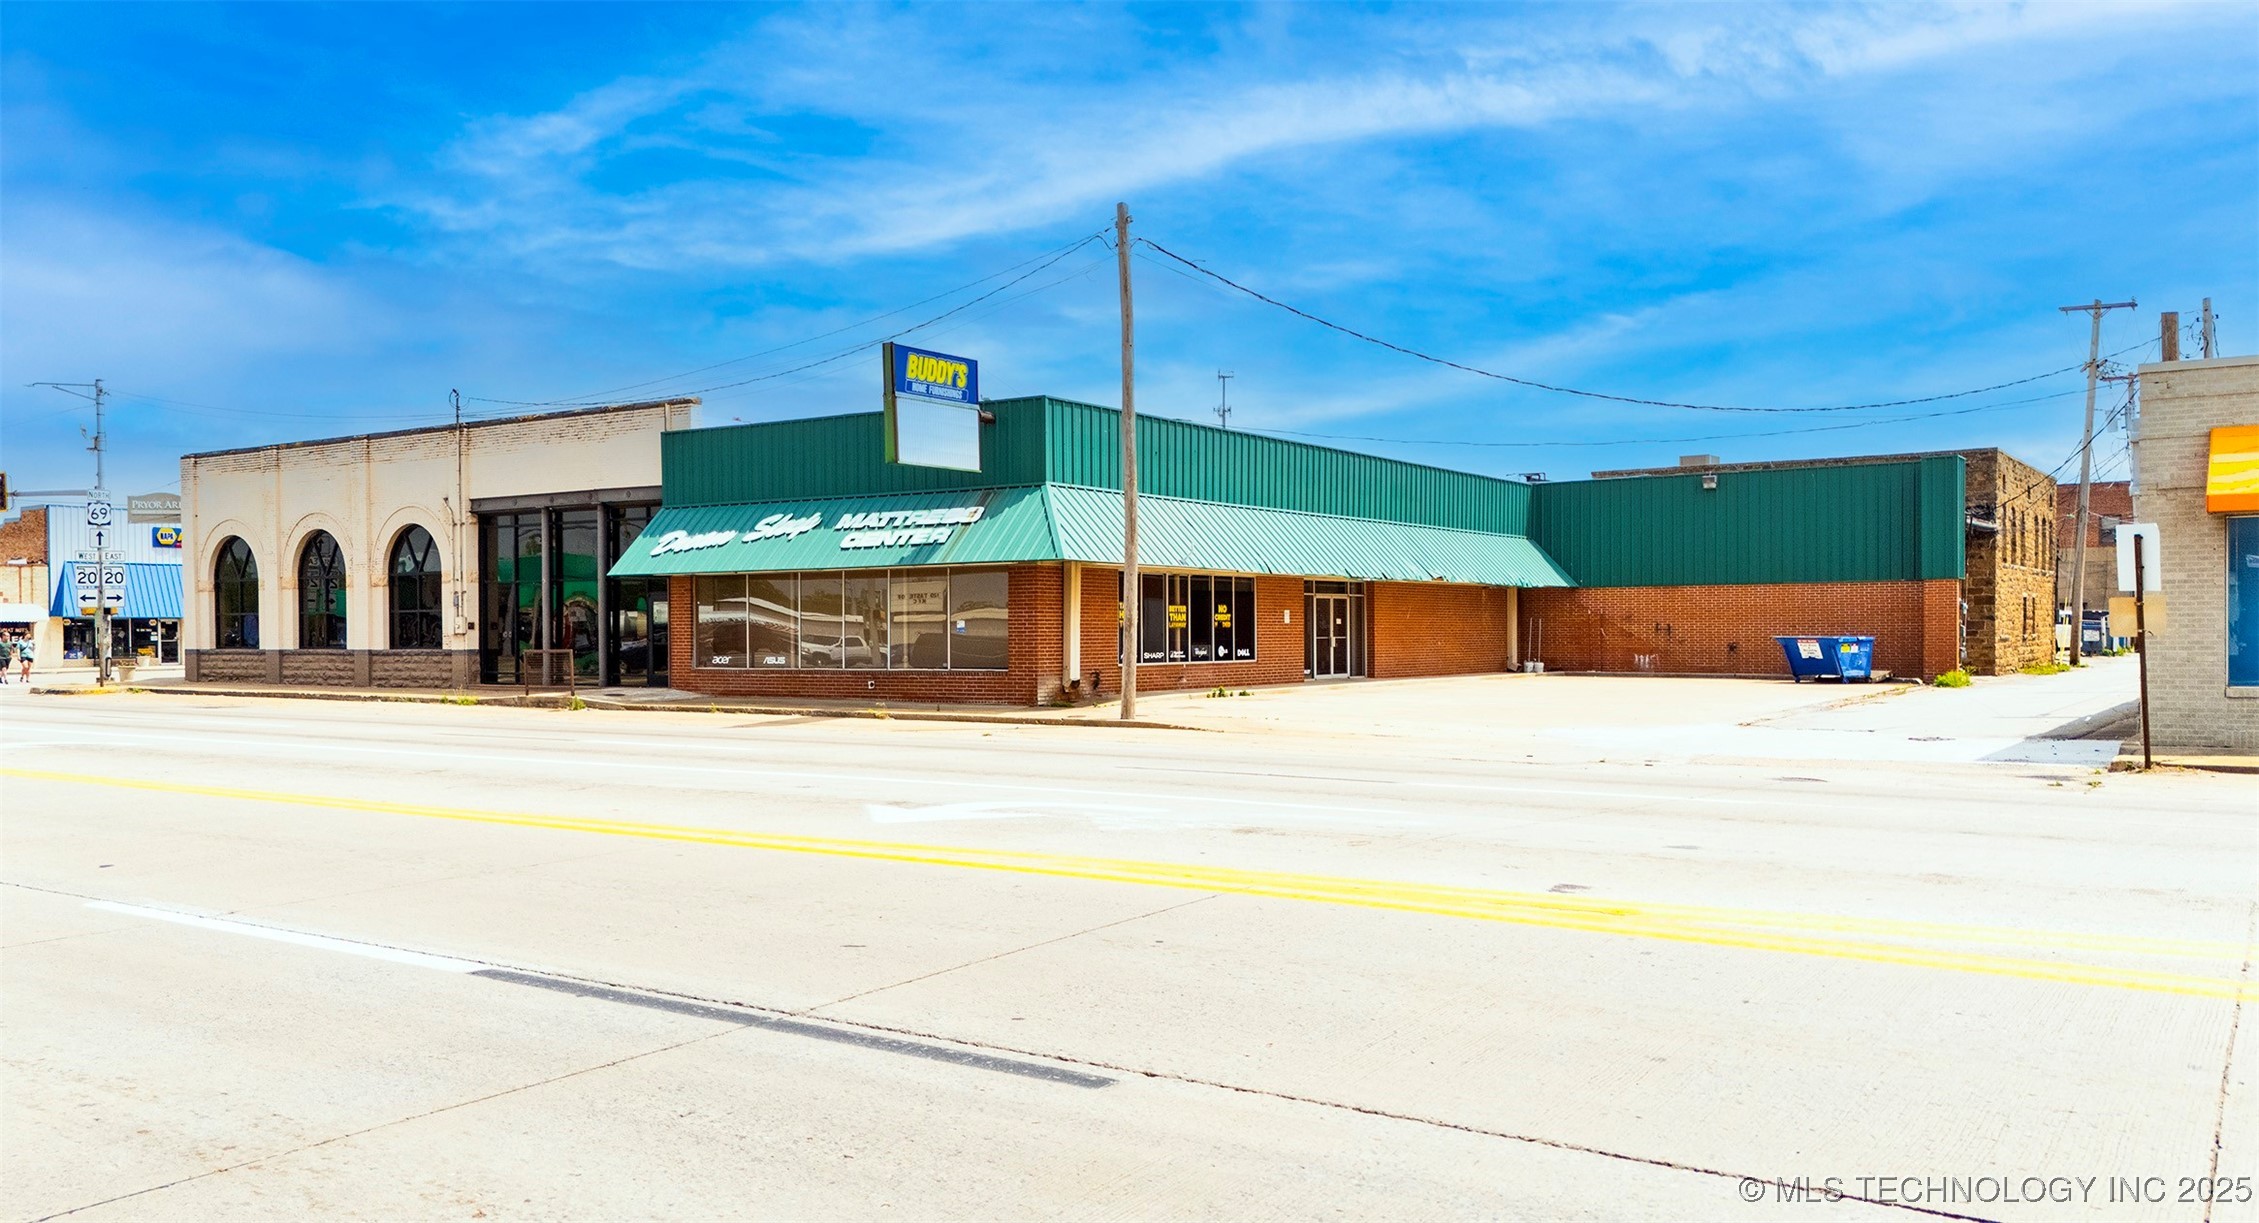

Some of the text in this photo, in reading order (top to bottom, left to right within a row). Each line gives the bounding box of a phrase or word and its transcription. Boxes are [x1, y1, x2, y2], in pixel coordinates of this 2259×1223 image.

[907, 353, 968, 389] BUDDY'S
[132, 500, 162, 509] PRYOR
[90, 507, 108, 520] 69
[839, 527, 953, 549] CENTER
[77, 571, 97, 584] 20
[104, 571, 124, 584] 20
[1169, 605, 1187, 613] BETTER
[1218, 604, 1228, 613] NO
[1170, 613, 1187, 621] THAN
[1215, 613, 1231, 621] CREDIT
[712, 656, 732, 664] acer
[763, 656, 786, 664] ASUS
